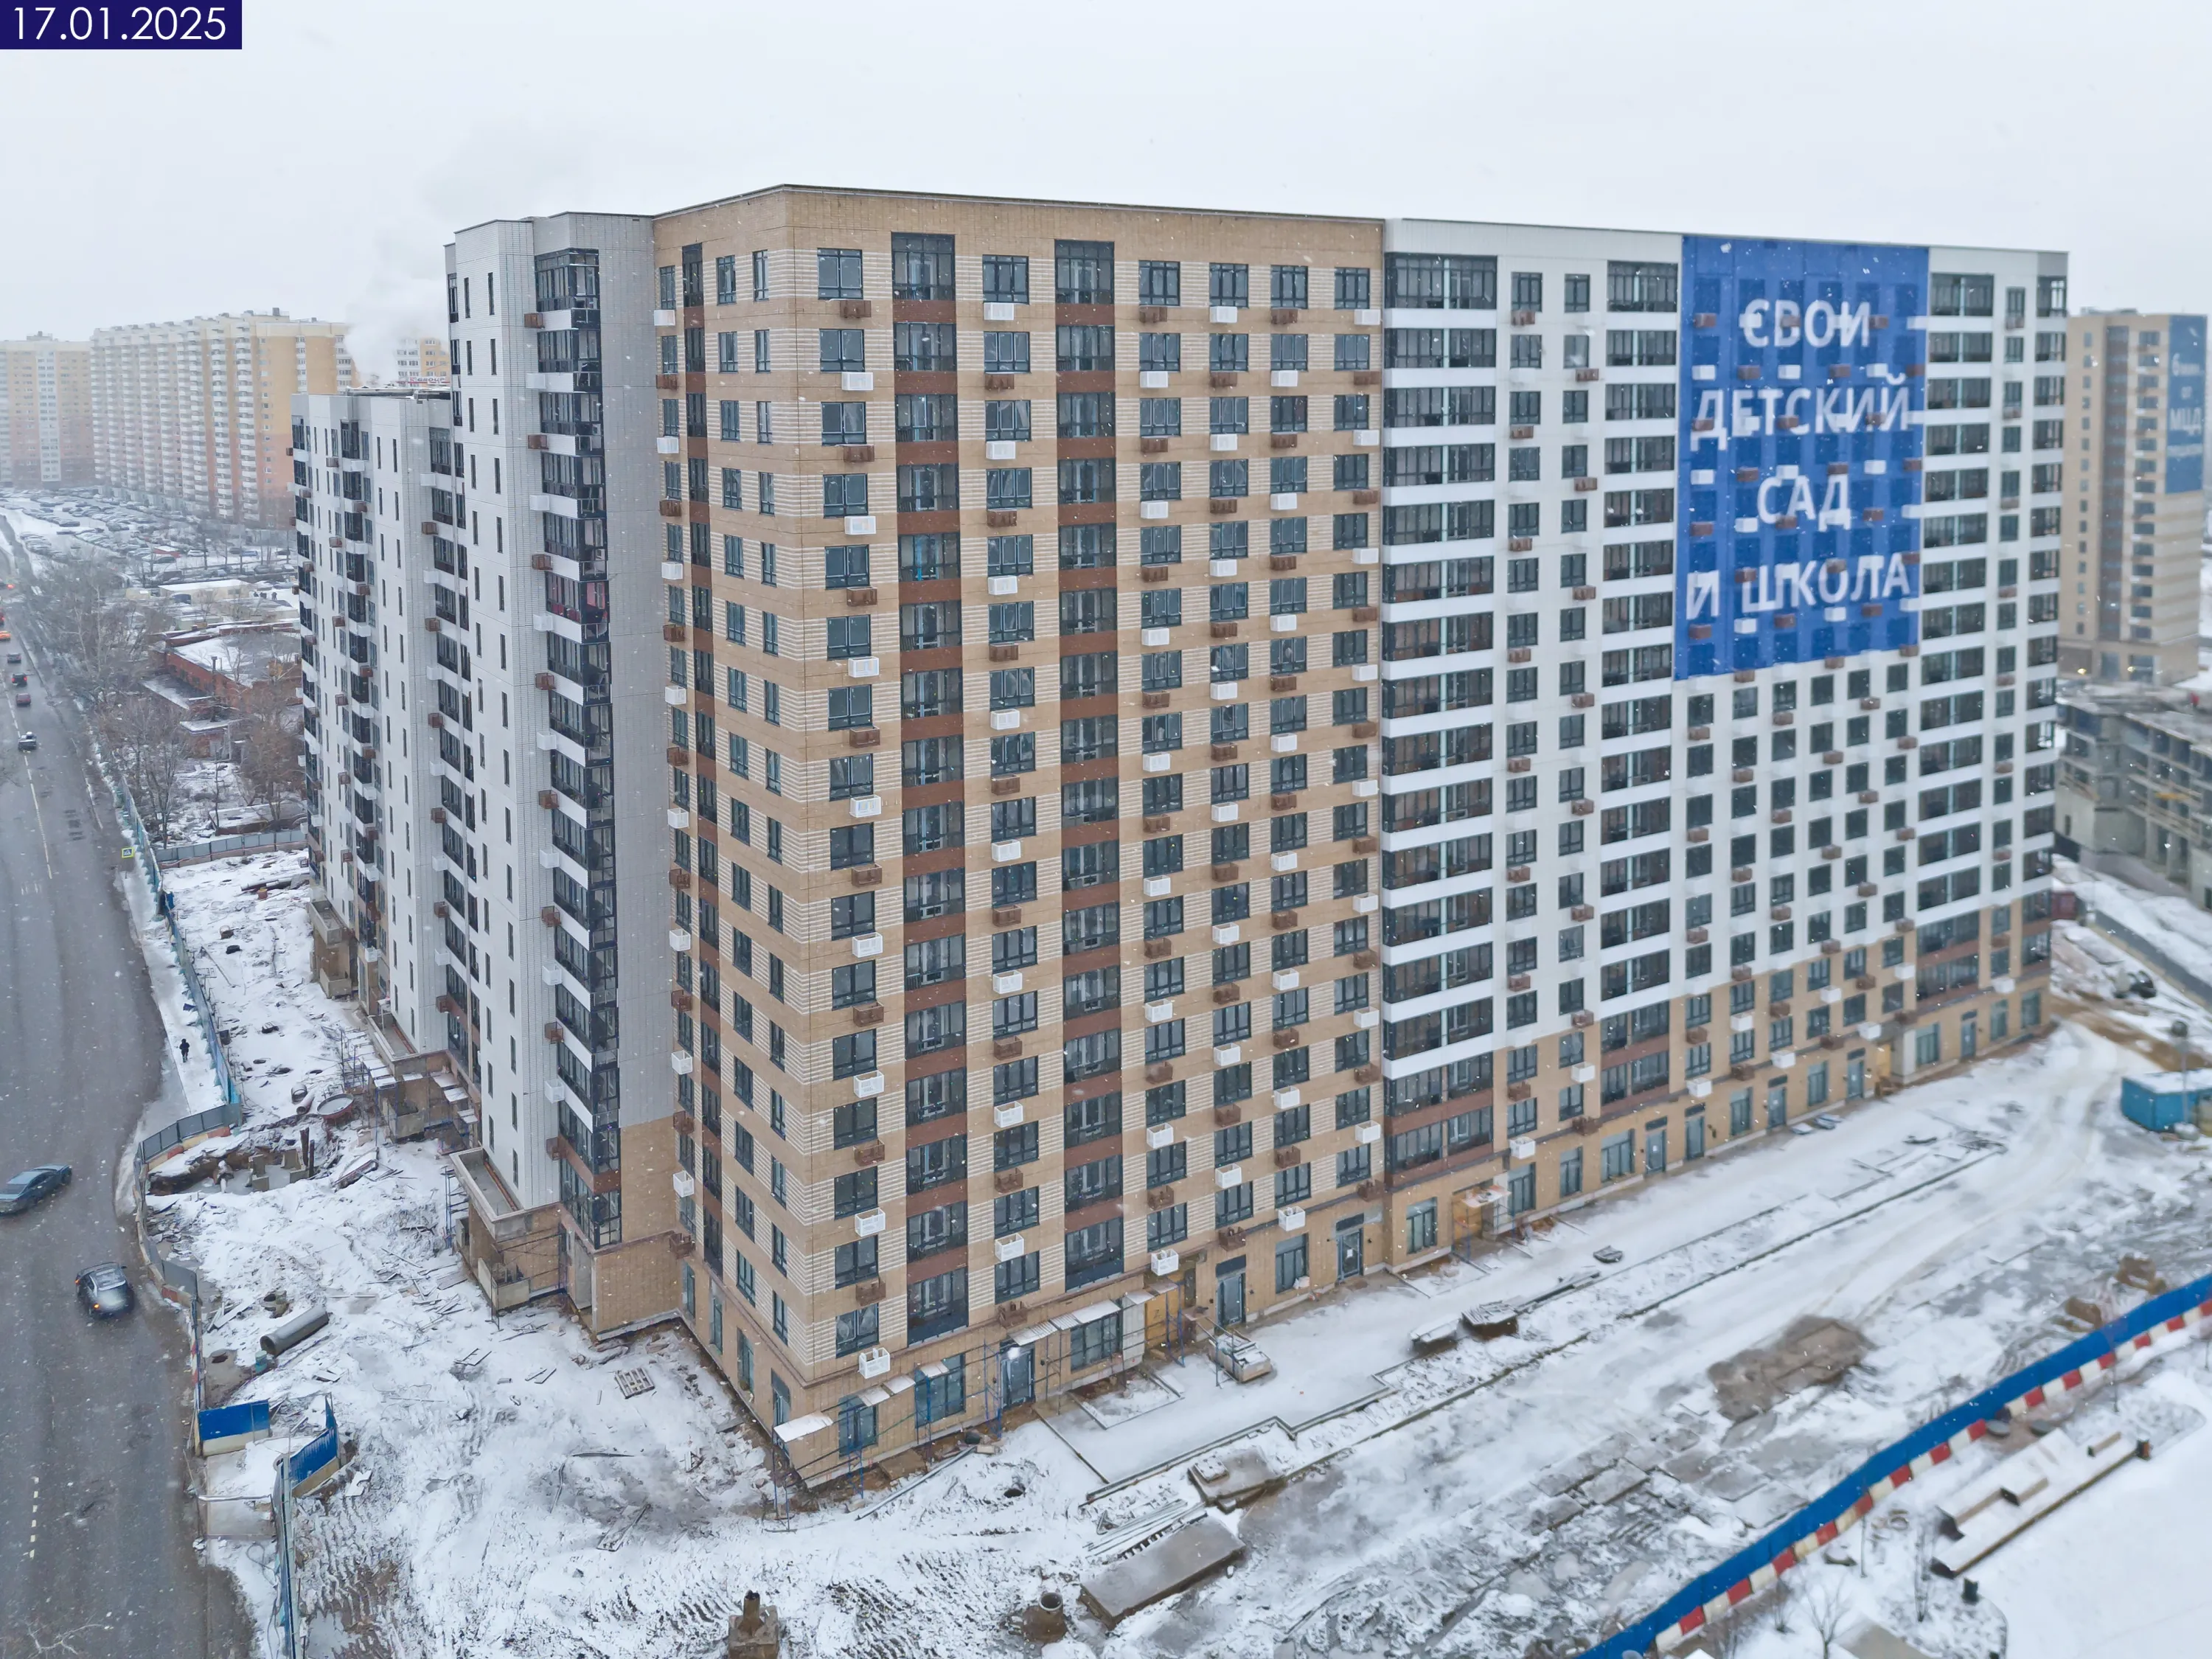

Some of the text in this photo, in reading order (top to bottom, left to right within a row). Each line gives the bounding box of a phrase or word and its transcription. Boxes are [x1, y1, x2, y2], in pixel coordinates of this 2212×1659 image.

[1690, 372, 1910, 452] ДЕТСКИЙ
[1756, 474, 1852, 532] САД
[1686, 552, 1911, 620] И ШКОЛА
